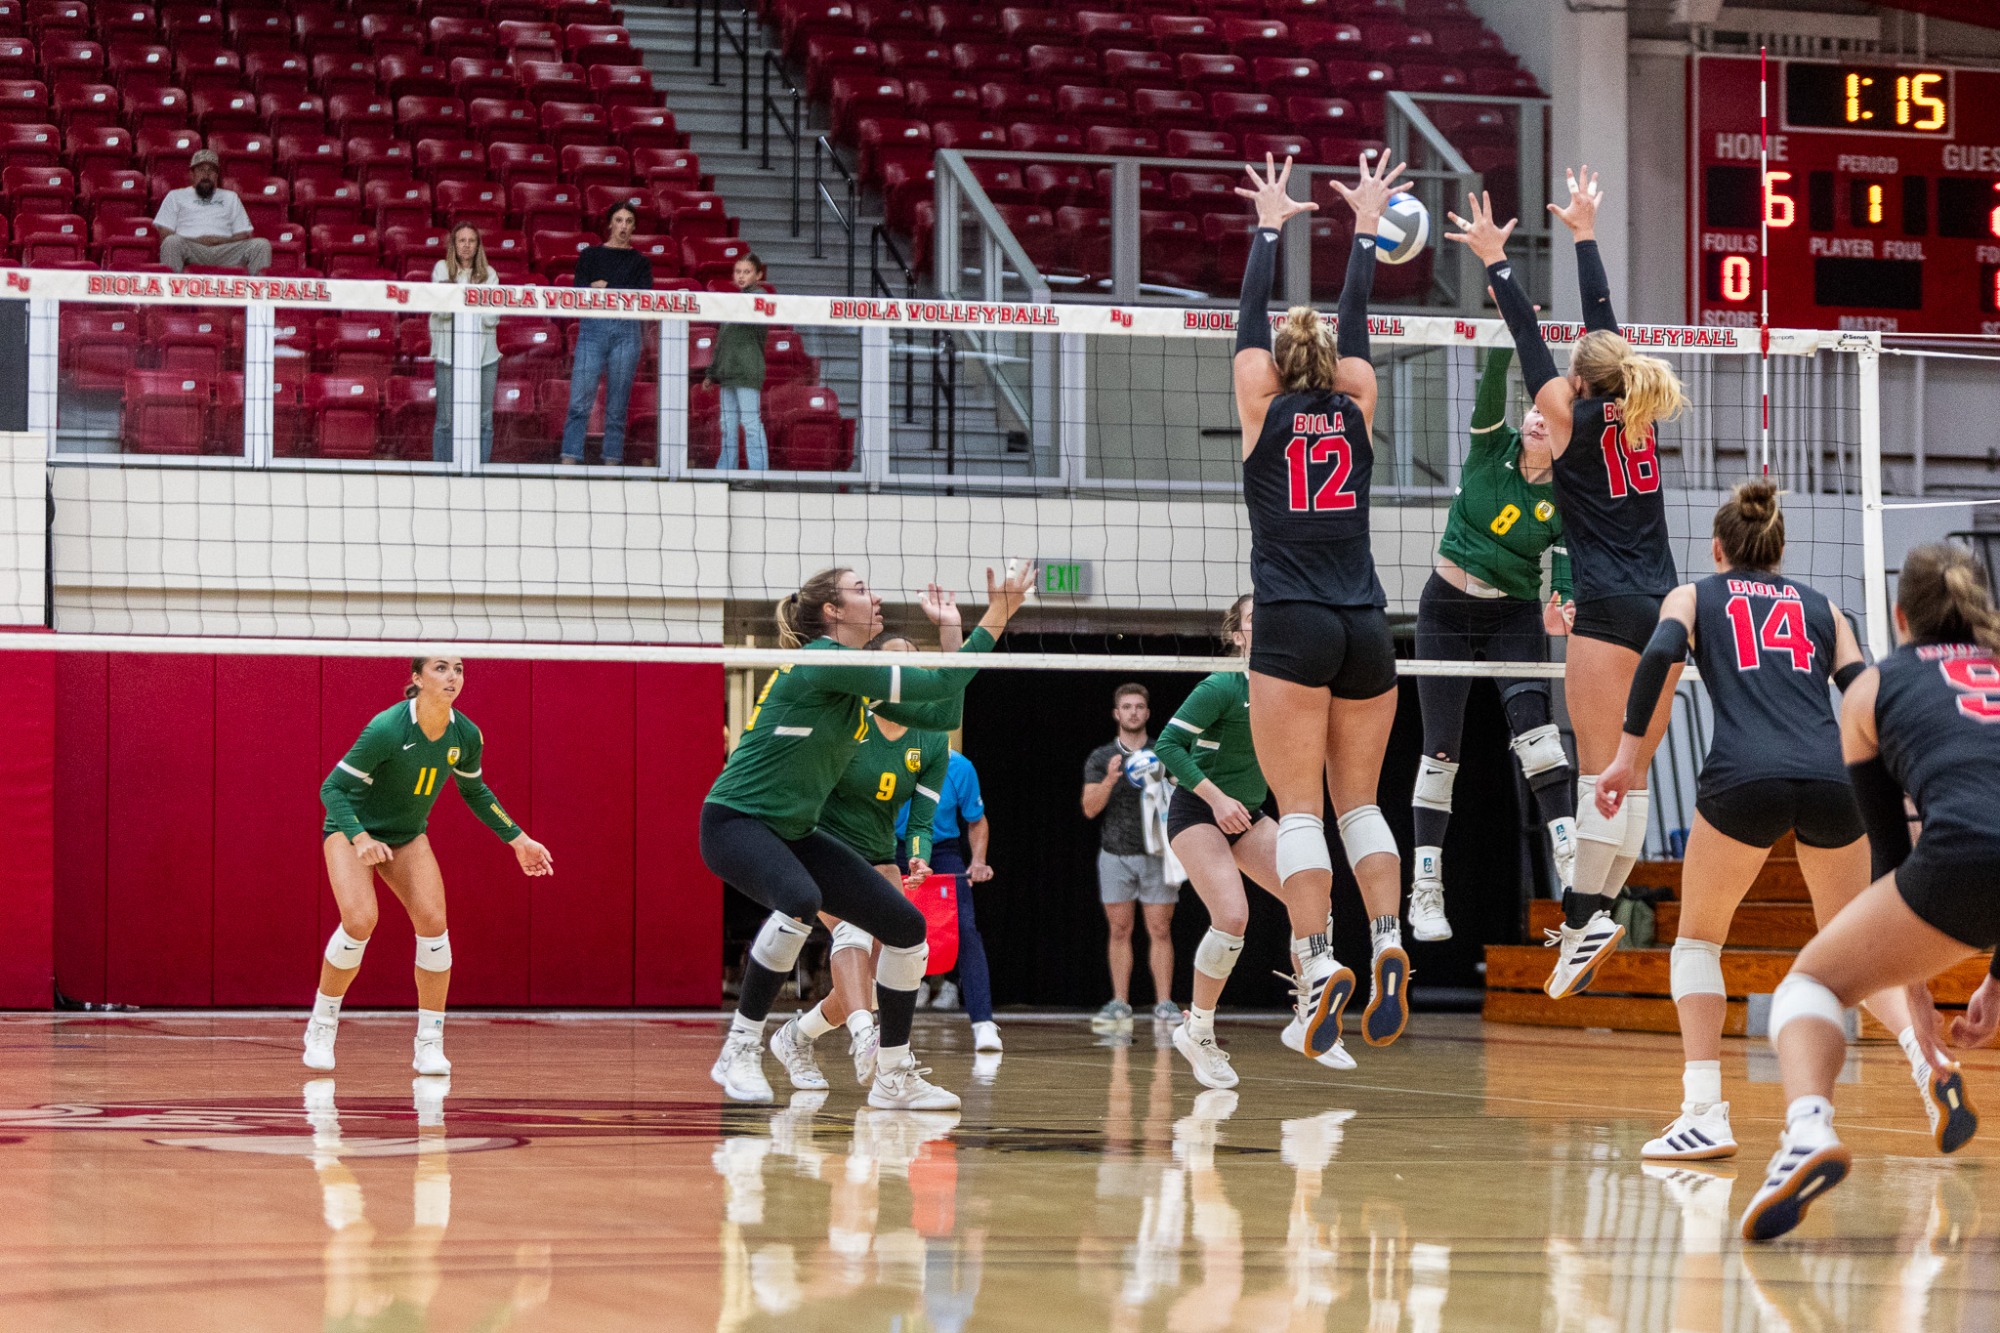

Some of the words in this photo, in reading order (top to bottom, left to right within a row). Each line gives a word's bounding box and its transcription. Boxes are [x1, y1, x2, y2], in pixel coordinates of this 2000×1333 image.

[1846, 73, 1946, 130] 1:15
[1715, 132, 1788, 161] HOME
[1943, 144, 2000, 172] GUES
[1838, 154, 1899, 174] PERIOD
[1765, 171, 1795, 228] 6
[1868, 184, 1883, 224] 1
[1703, 233, 1759, 252] FOULS
[1809, 237, 1874, 257] PLAYER
[1882, 240, 1926, 260] FOUL
[7, 272, 31, 292] BU
[88, 274, 163, 296] BIOLA
[168, 276, 332, 301] VOLLEYBALL
[1721, 255, 1751, 301] 0
[386, 285, 410, 304] BU
[465, 287, 538, 308] BIOLA
[543, 288, 701, 313] VOLLEYBALL
[753, 297, 777, 316] BU
[830, 300, 902, 320] BIOLA
[905, 301, 1059, 325] VOLLEYBALL
[1110, 309, 1134, 328] BU
[1184, 310, 1239, 330] BIOL
[1702, 309, 1758, 327] SCORE
[1454, 320, 1477, 340] BU
[1540, 323, 1588, 343] IOL
[1617, 325, 1738, 347] LLEYBALL
[1293, 412, 1346, 433] BIOLA
[1285, 435, 1357, 512] 12
[1600, 424, 1661, 498] 18
[1490, 504, 1521, 536] 8
[1046, 563, 1081, 592] EXIT
[1726, 579, 1801, 600] BIOLA
[1725, 595, 1816, 673] 14
[413, 767, 438, 796] 11
[875, 771, 897, 801] 9
